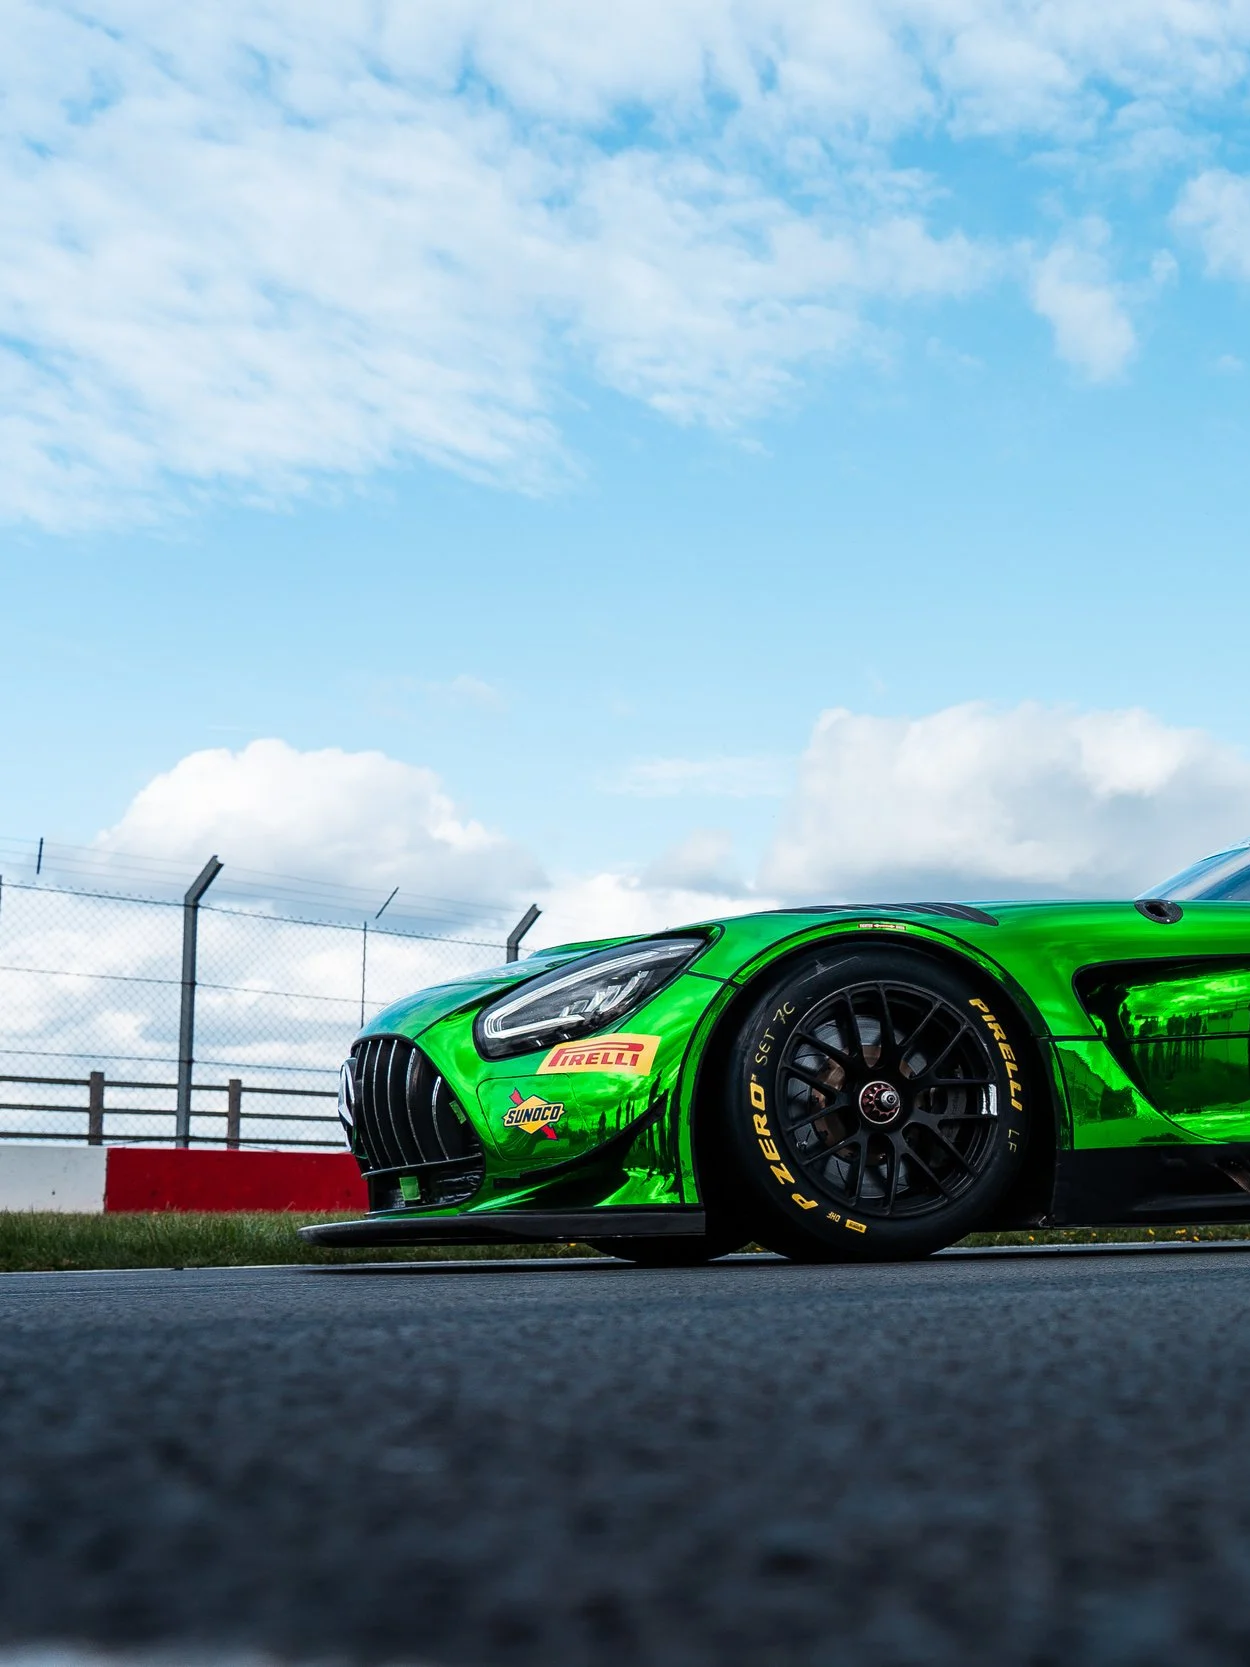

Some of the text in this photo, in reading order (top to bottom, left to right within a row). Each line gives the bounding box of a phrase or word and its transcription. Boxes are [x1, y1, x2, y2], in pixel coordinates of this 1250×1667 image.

[548, 1041, 645, 1067] PIRELLI
[754, 1027, 776, 1067] SET
[969, 998, 1024, 1112] PIRELLI
[505, 1105, 561, 1125] SUNOCO
